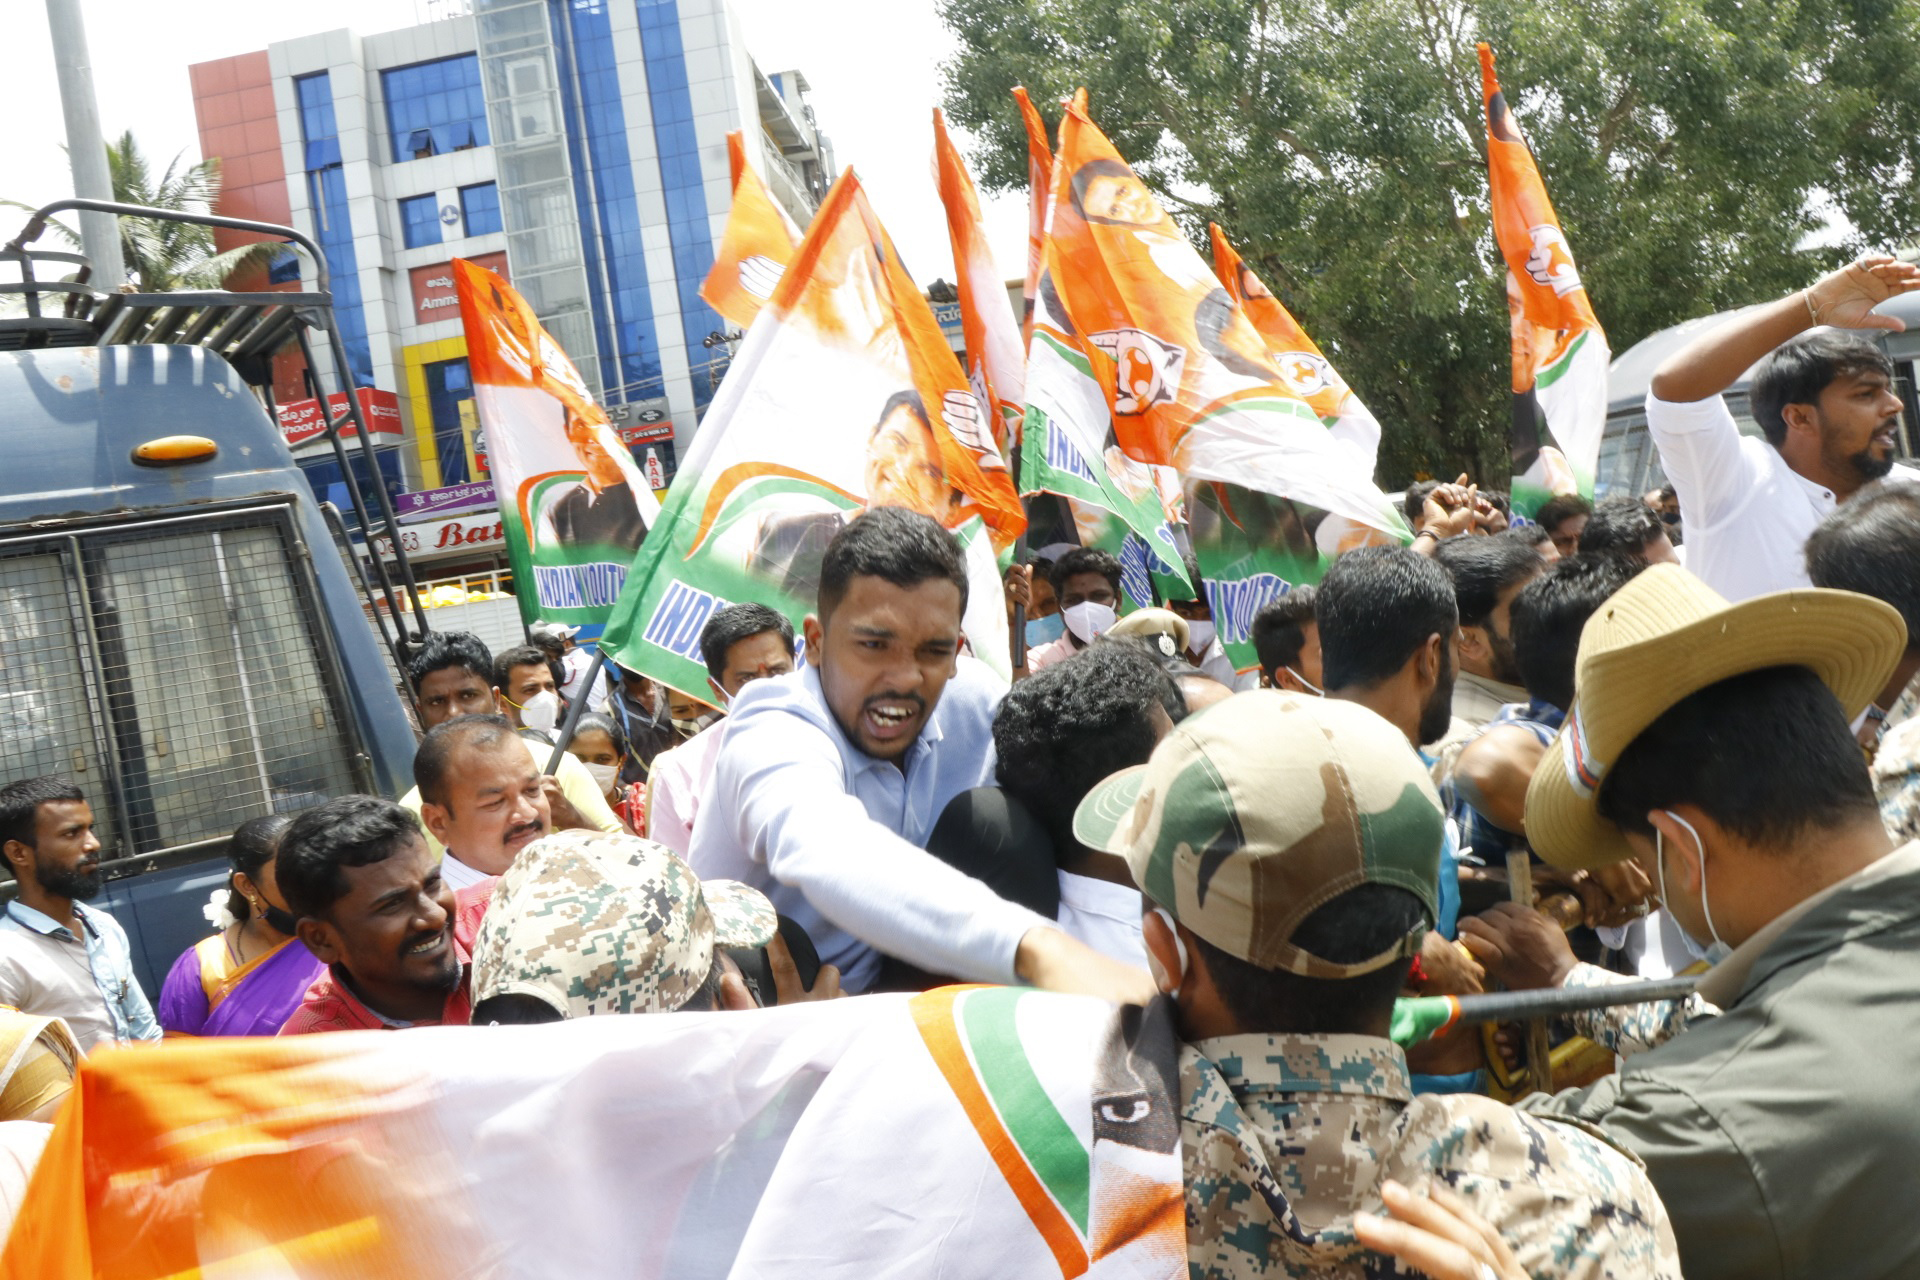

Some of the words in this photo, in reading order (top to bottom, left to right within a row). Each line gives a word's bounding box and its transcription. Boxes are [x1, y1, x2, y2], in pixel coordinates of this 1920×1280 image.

[648, 457, 661, 488] BAR
[434, 519, 504, 549] Bat
[532, 565, 586, 609] INDIAN
